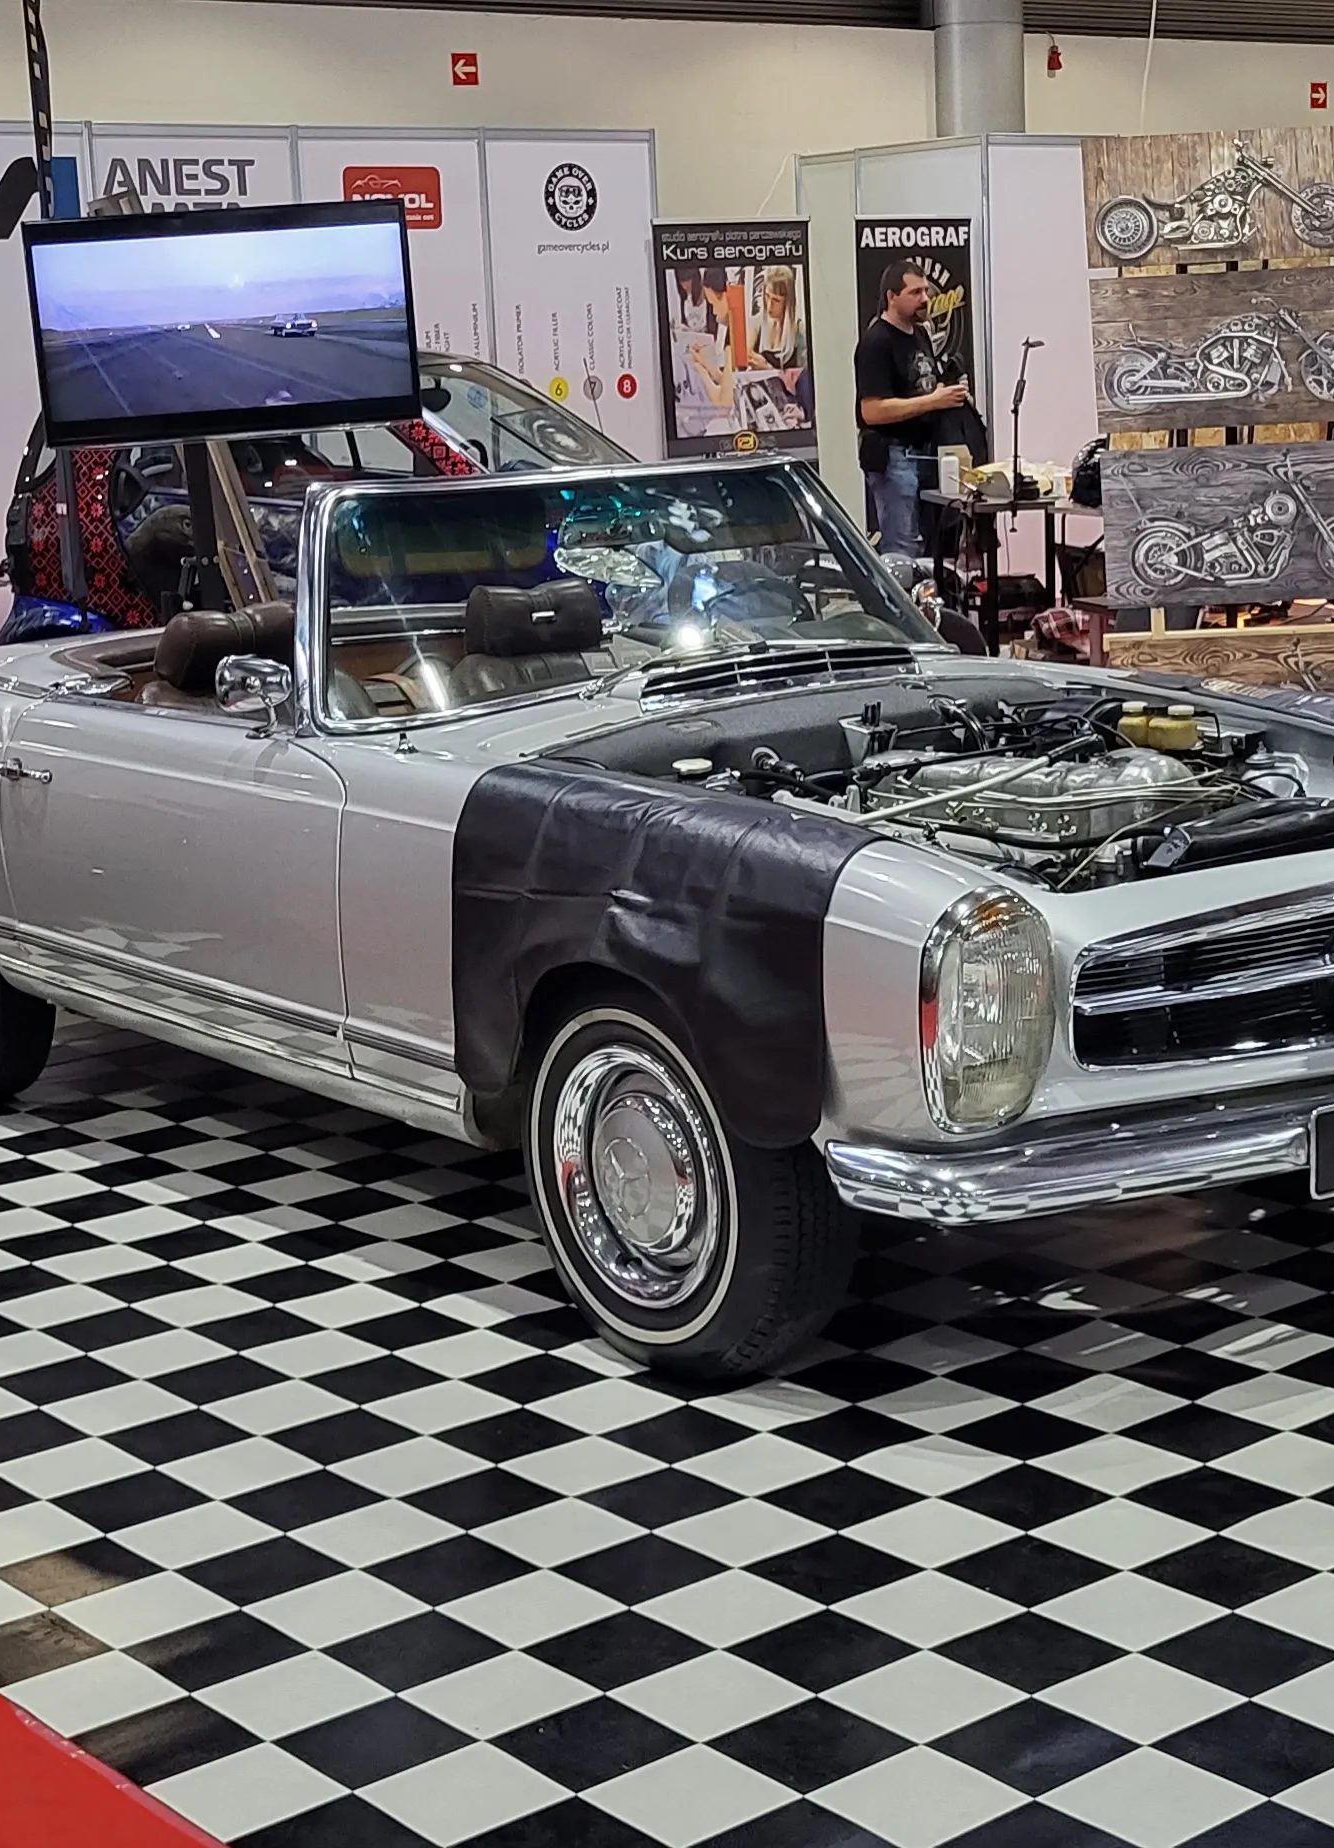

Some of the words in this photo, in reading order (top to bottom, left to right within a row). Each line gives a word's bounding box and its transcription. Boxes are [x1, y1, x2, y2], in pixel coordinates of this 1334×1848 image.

[102, 158, 256, 197] ANEST
[548, 167, 570, 191] GAME
[572, 168, 593, 191] OVER
[555, 213, 588, 227] CYCLES
[537, 241, 610, 254] gameovercycles.pl
[860, 226, 968, 248] AEROGRAF
[662, 244, 708, 261] Kurs
[714, 241, 803, 260] aerografu
[586, 303, 594, 337] COLORS
[615, 286, 624, 335] CLEARCOAT
[552, 338, 560, 372] ACRYLIC
[555, 384, 563, 396] 6
[623, 381, 631, 393] 8
